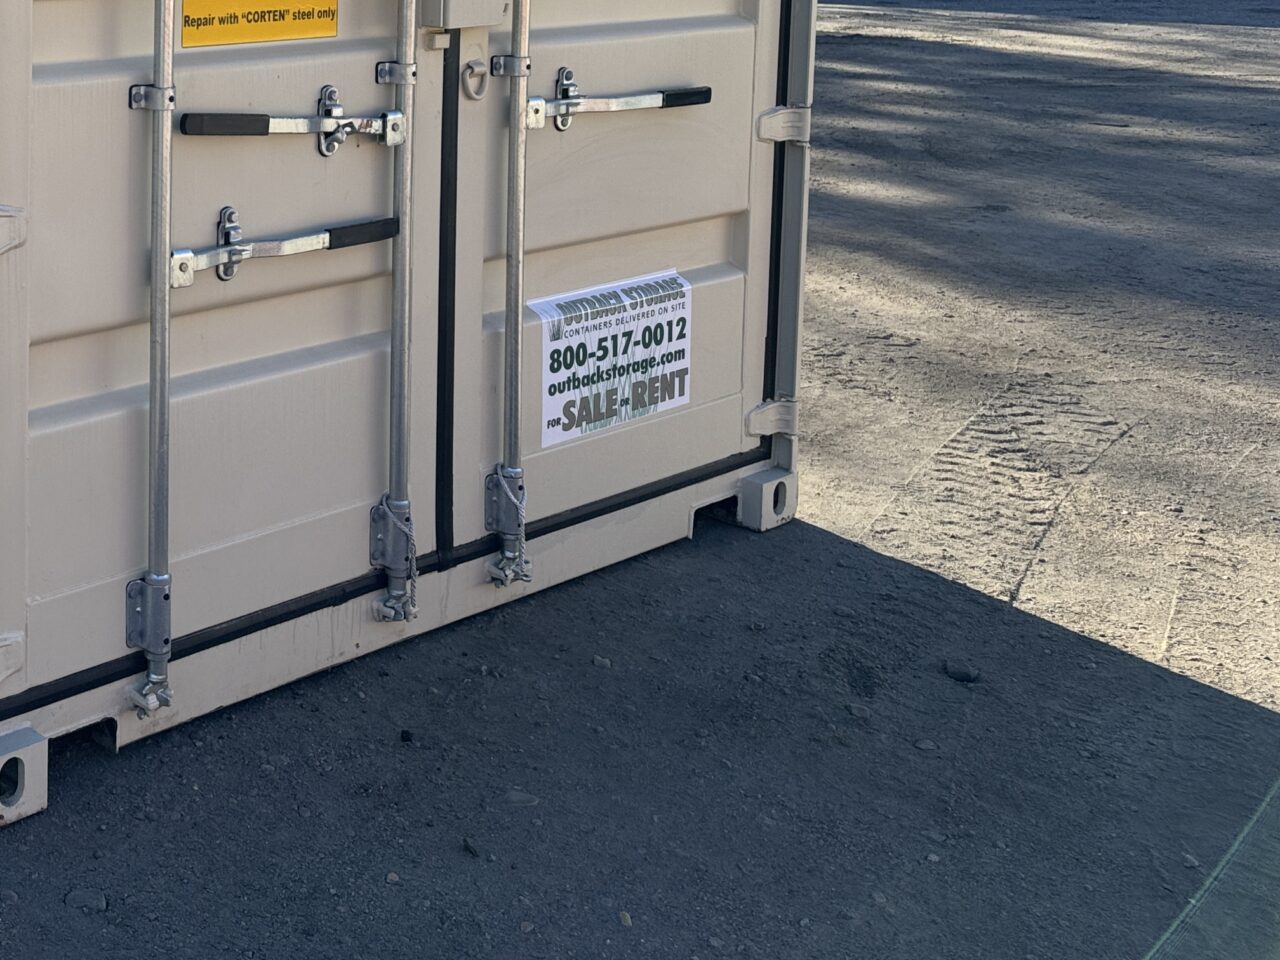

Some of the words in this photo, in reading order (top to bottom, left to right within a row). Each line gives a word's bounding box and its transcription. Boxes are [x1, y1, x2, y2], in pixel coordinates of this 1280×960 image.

[183, 13, 216, 30] Repair
[219, 12, 239, 26] with
[292, 7, 315, 21] steel
[317, 6, 336, 22] only
[555, 290, 627, 326] OUTBACK
[621, 276, 686, 311] STORAGE
[563, 320, 613, 339] CONTAINERS
[615, 307, 656, 326] DELIVERED
[657, 306, 668, 316] ON
[670, 301, 686, 312] SITE
[549, 316, 687, 374] 800-517-0012
[548, 348, 685, 396] outbackstorage.com
[547, 417, 562, 429] FOR
[562, 387, 618, 432] SALE
[620, 397, 630, 408] OR
[631, 367, 689, 412] RENT
